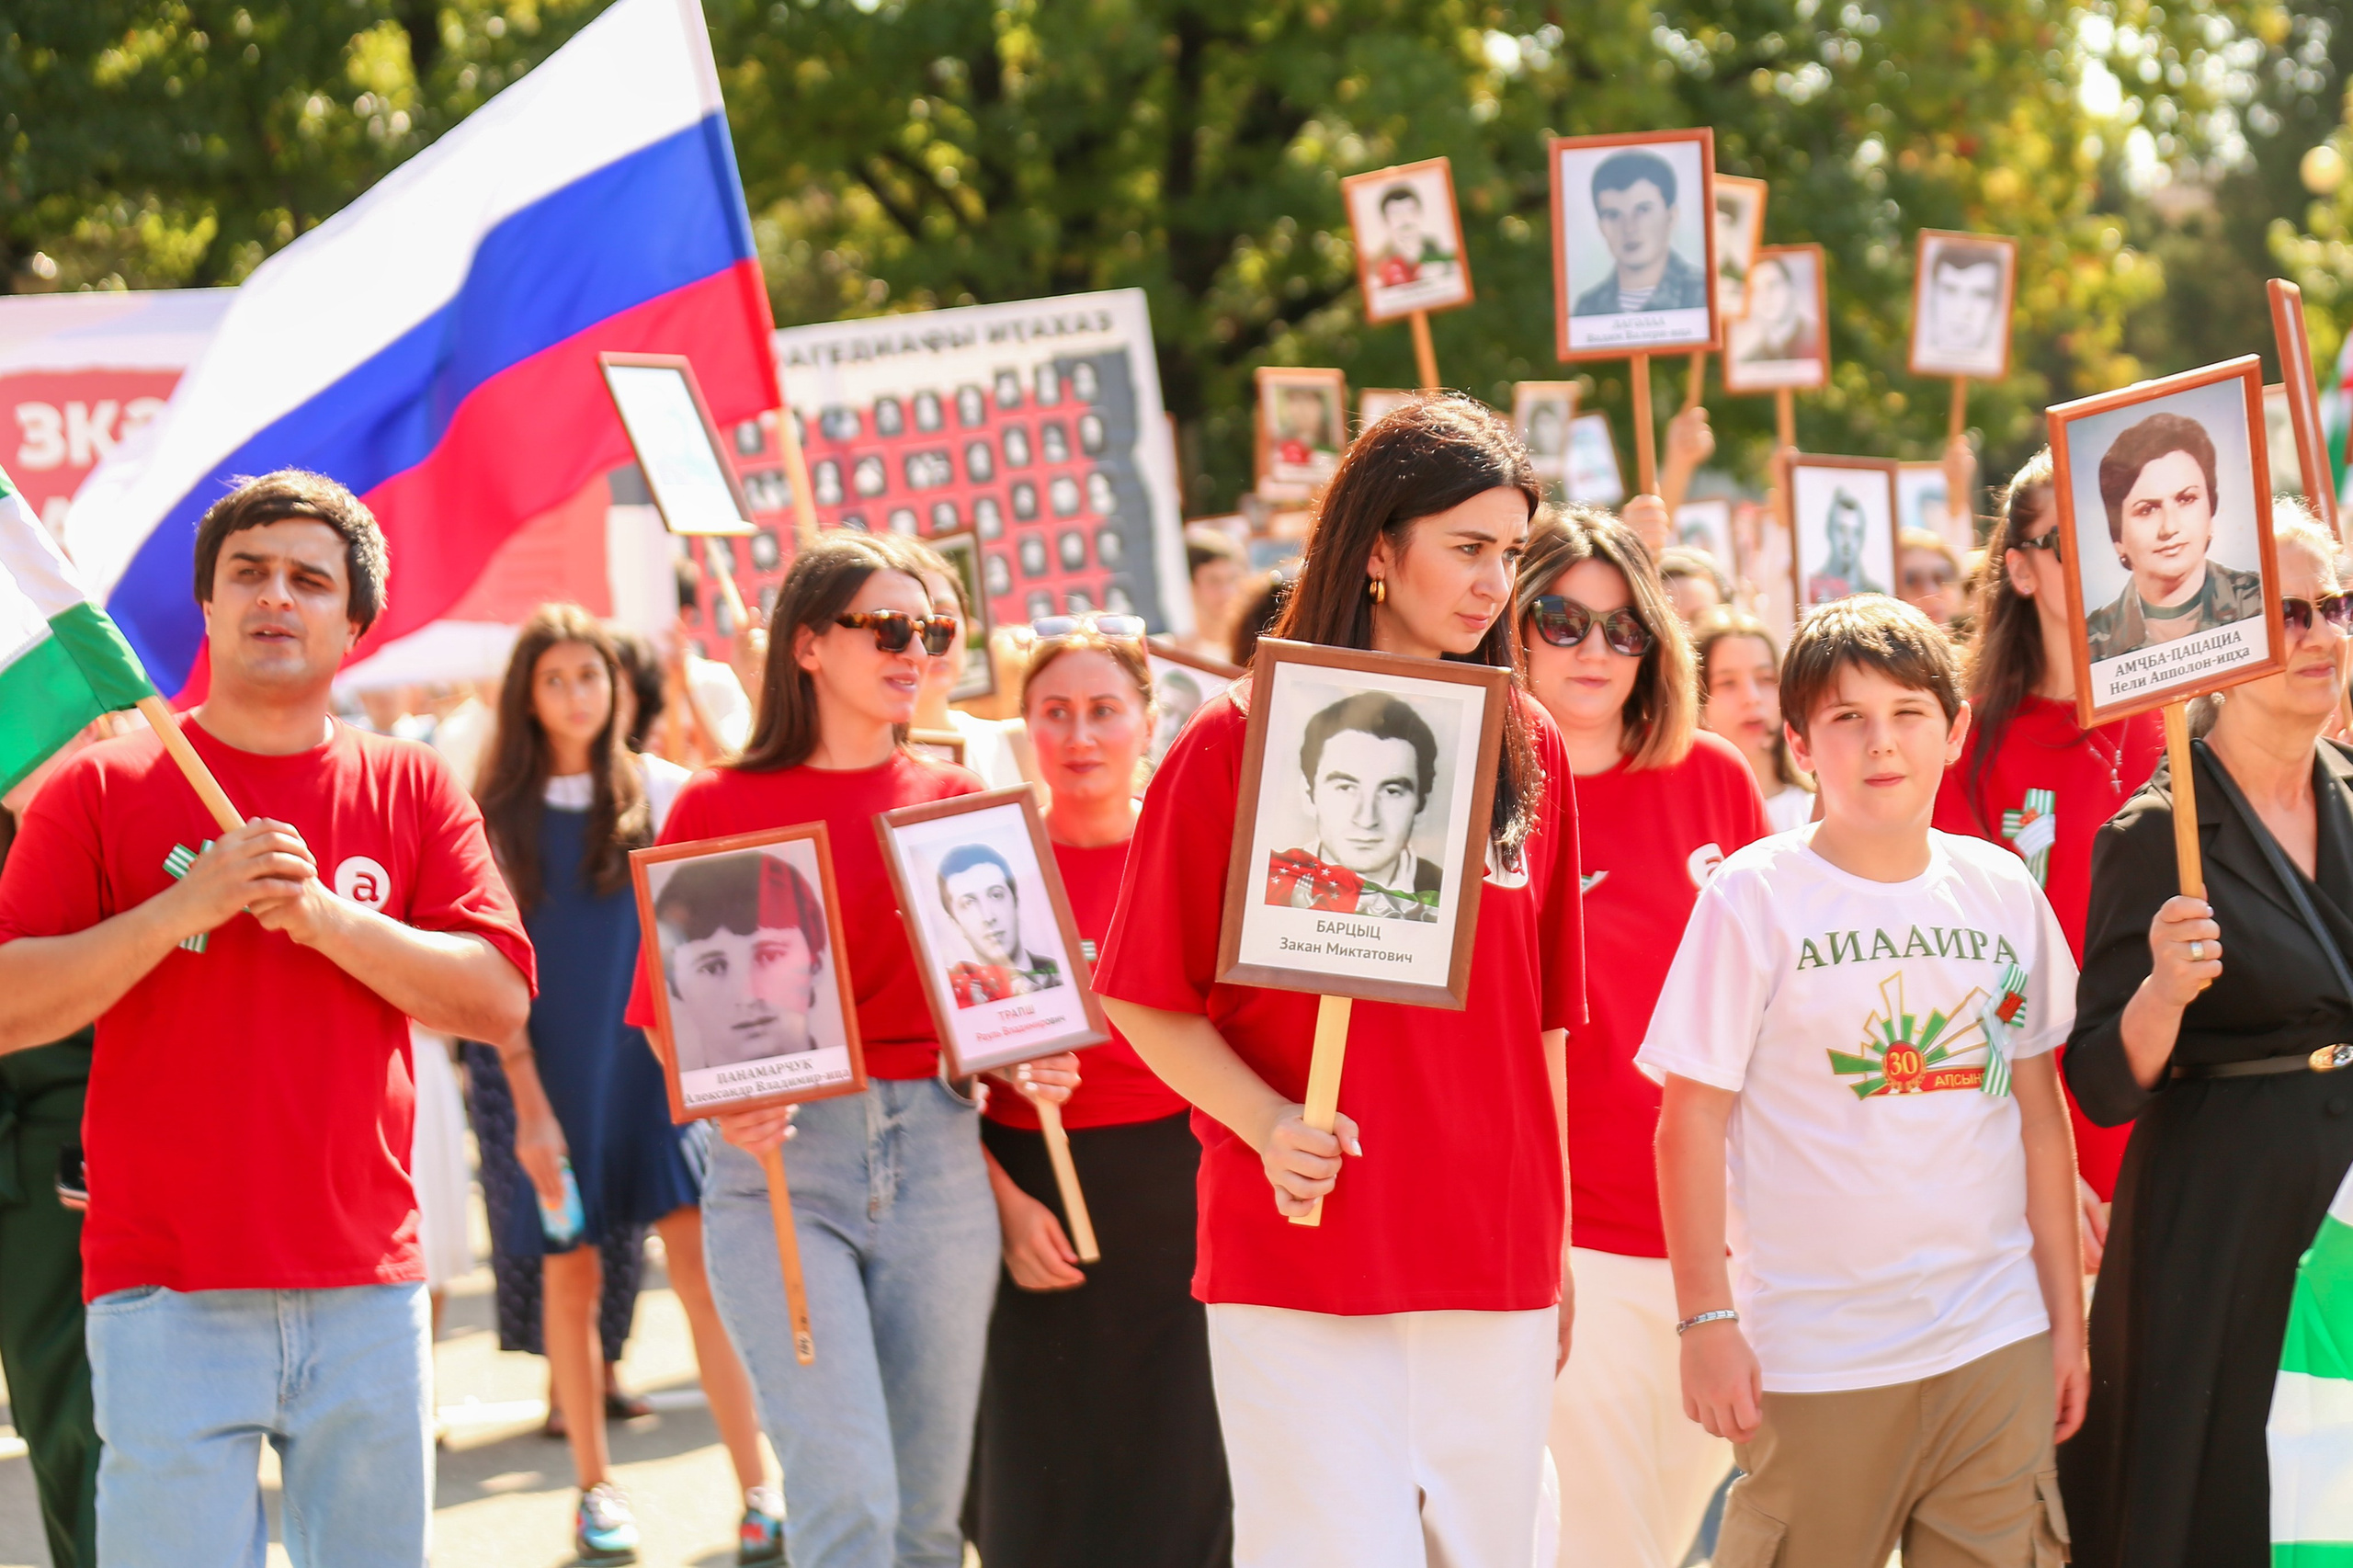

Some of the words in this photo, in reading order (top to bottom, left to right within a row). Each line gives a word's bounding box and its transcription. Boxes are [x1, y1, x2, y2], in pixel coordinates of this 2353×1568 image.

[2109, 676, 2148, 697] Нели
[1315, 919, 1381, 941] БАРЦЫЦ
[1279, 936, 1322, 954] Закан
[1325, 941, 1414, 963] Миктатович
[1796, 924, 2020, 971] АИААИРА
[1002, 1015, 1067, 1036] Владимирович
[715, 1057, 813, 1085] ПАНАМАРЧУК
[1889, 1050, 1918, 1076] 30
[685, 1083, 754, 1104] Александр
